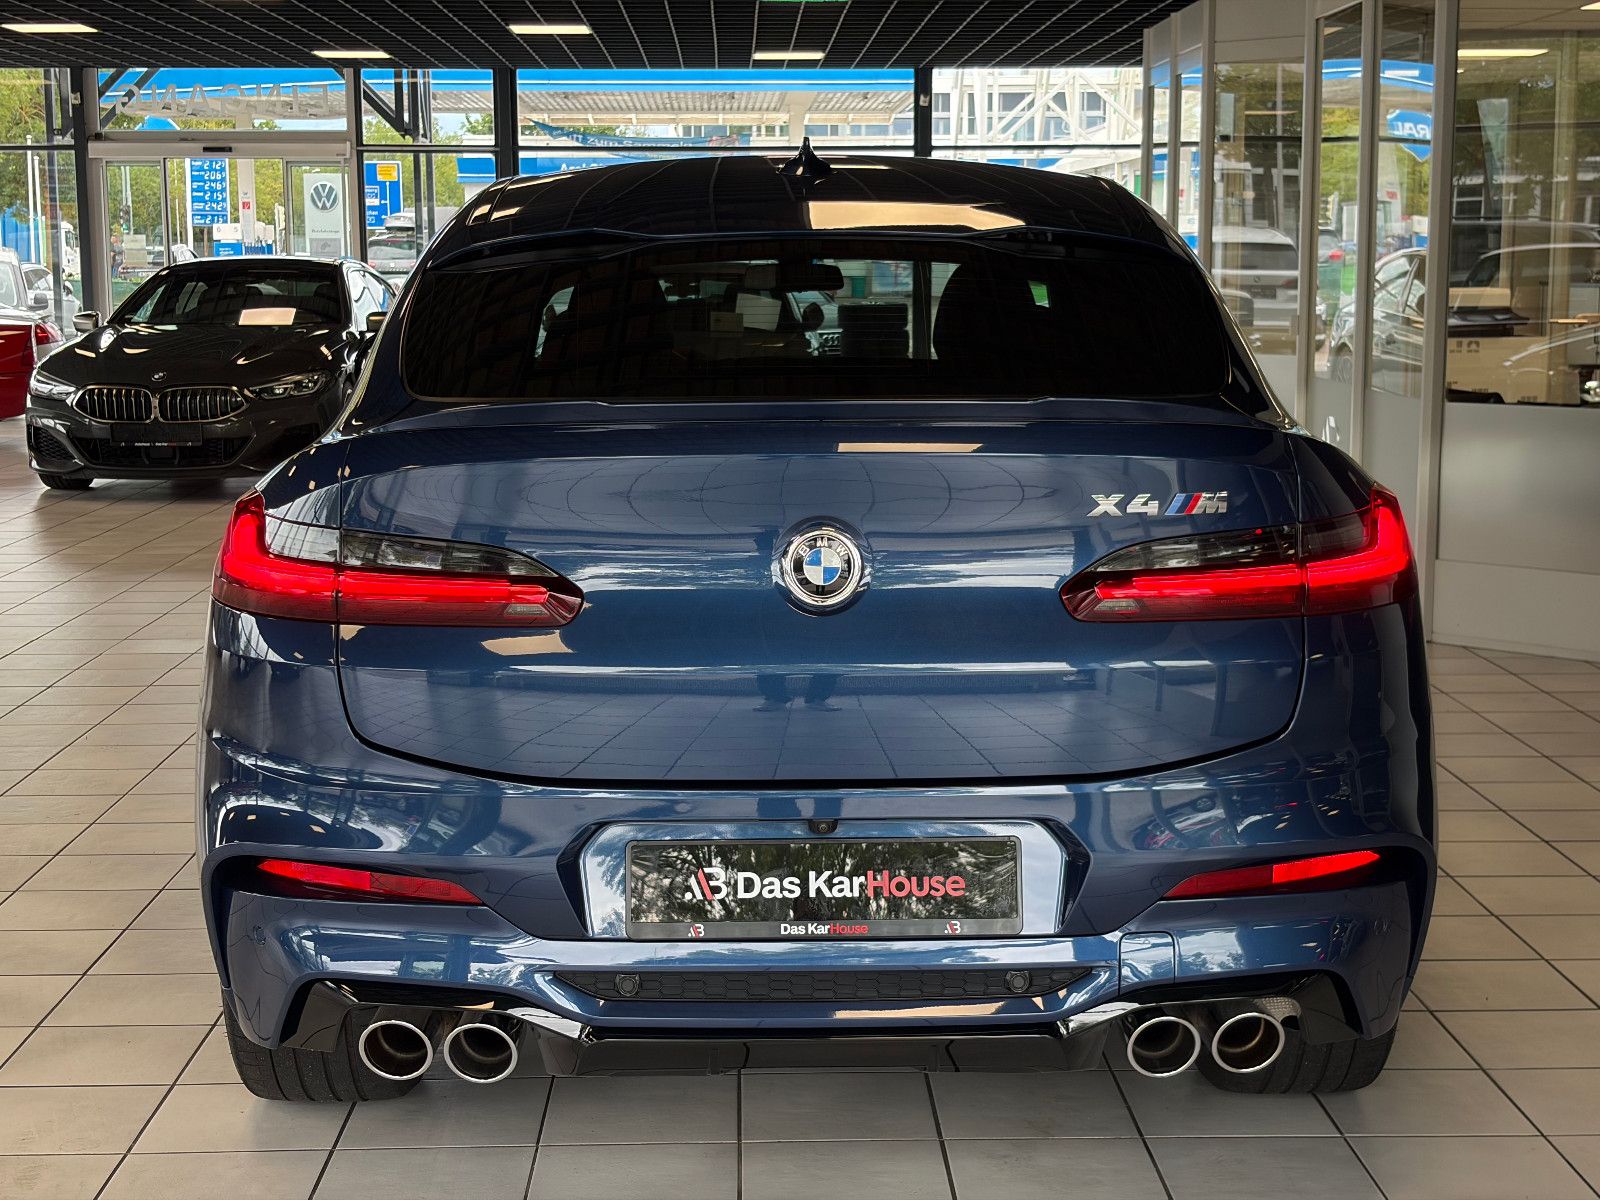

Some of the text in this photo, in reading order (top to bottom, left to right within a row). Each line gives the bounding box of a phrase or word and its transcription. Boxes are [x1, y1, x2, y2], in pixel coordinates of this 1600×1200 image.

[798, 536, 848, 558] BMW
[737, 871, 801, 899] Das
[809, 870, 966, 899] KarHouse
[780, 922, 868, 935] Das KarHouse
